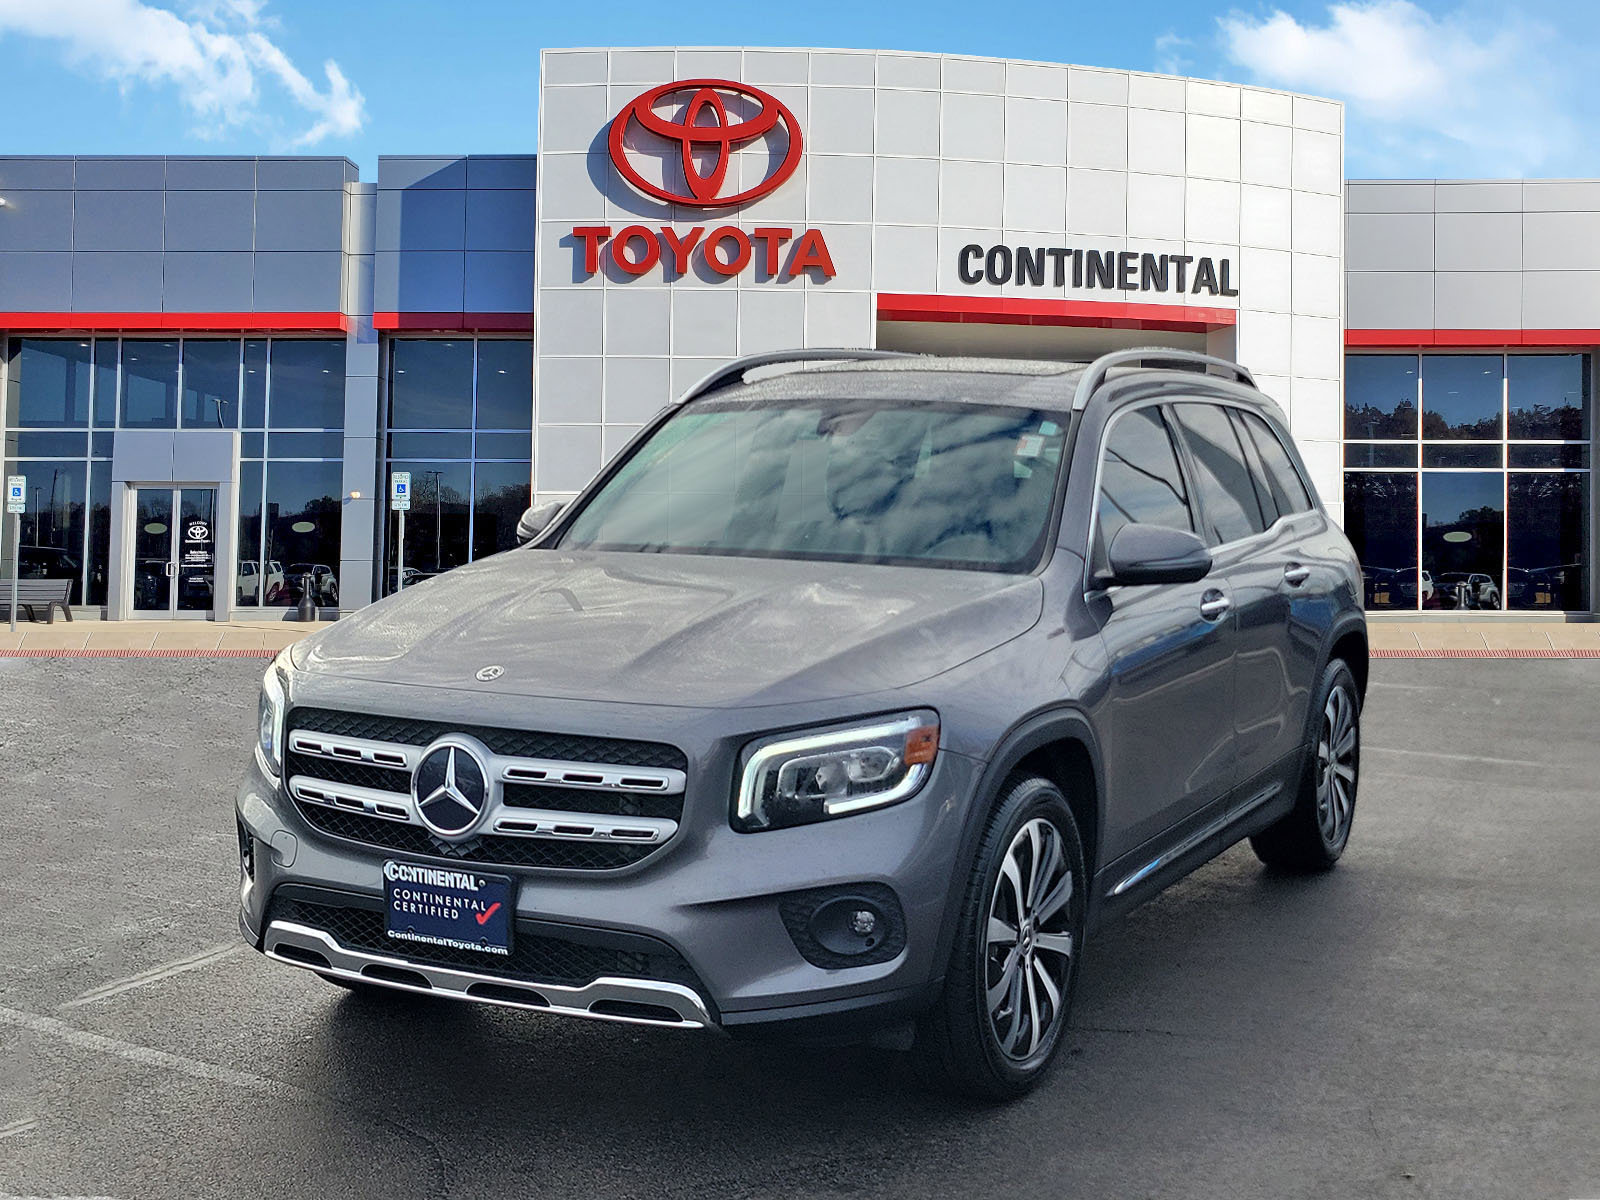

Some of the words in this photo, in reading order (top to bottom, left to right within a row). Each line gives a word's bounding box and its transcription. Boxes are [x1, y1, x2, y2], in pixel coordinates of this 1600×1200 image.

[573, 225, 836, 276] TOYOTA
[958, 244, 1239, 297] CONTINENTAL
[384, 861, 479, 891] CONTINENTAL
[393, 888, 486, 911] CONTINENTAL
[393, 901, 459, 920] CERTIFIED
[387, 930, 508, 955] ContinentalToyota.com
